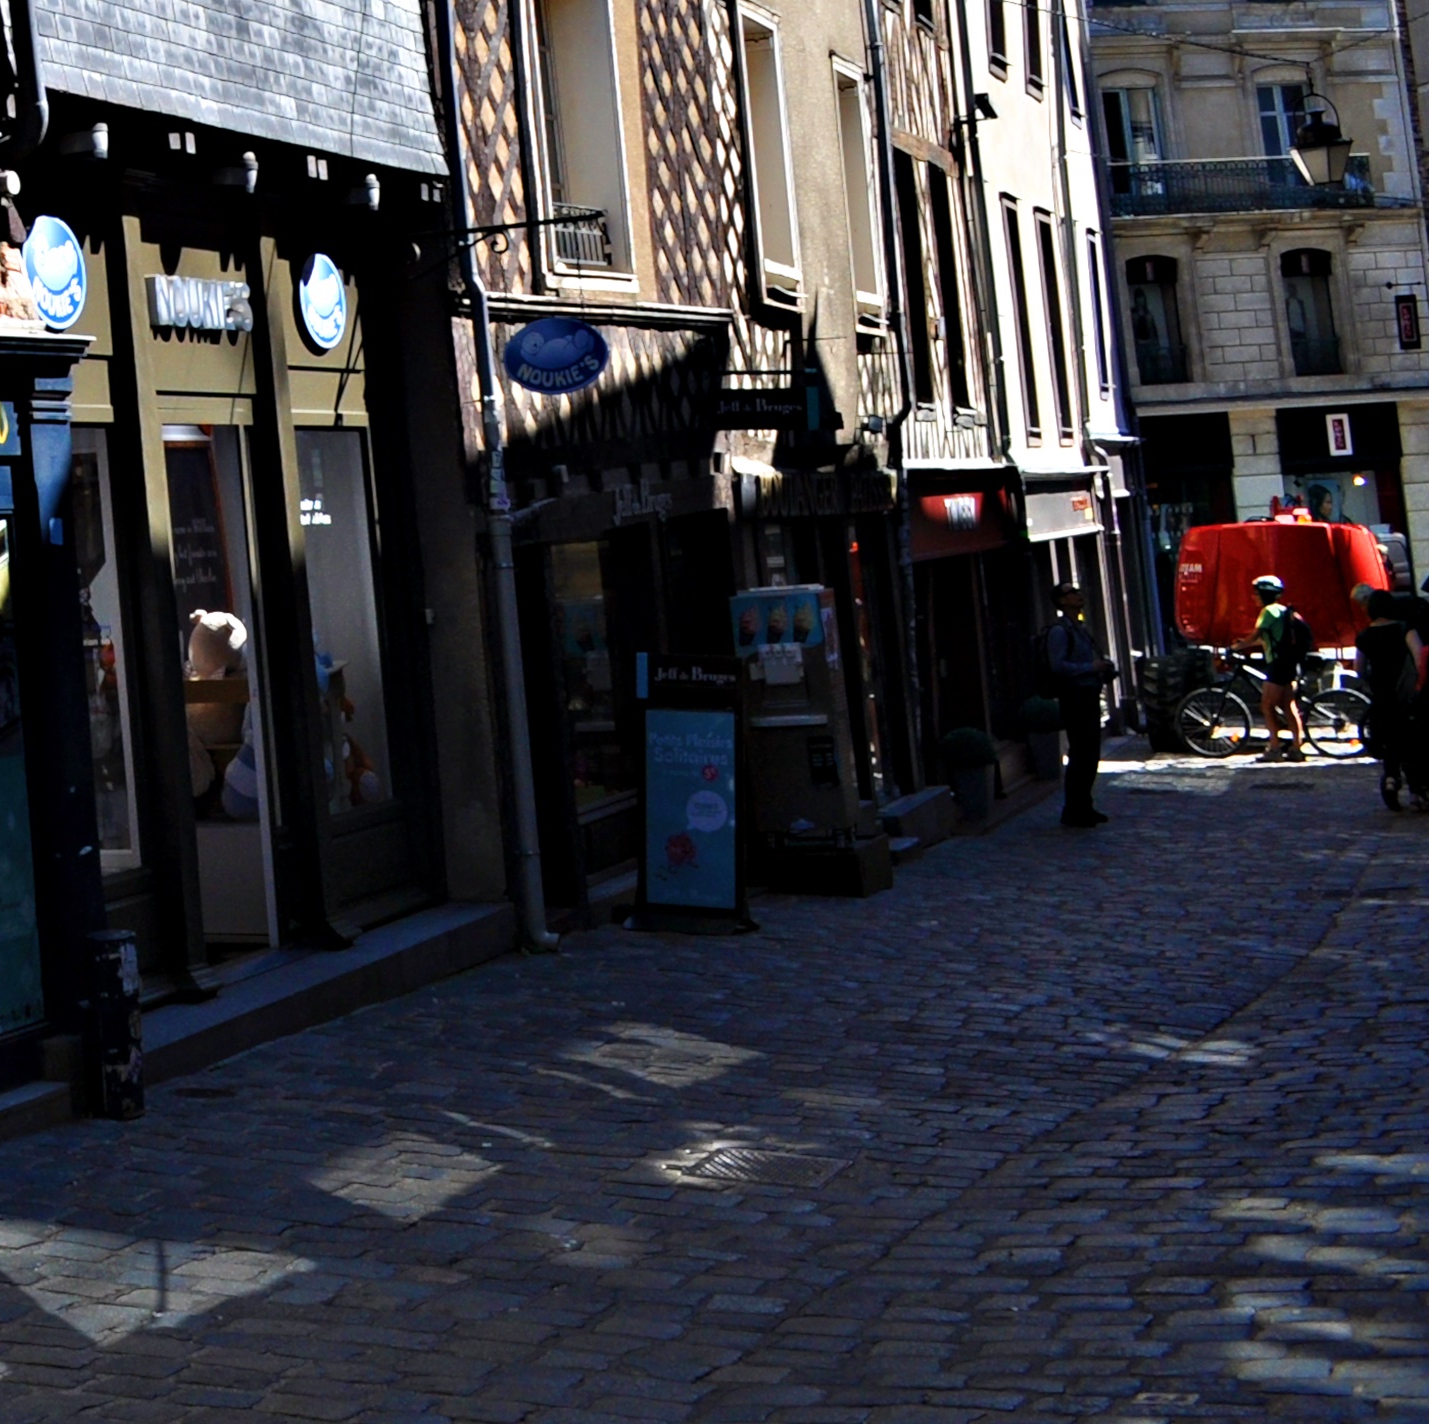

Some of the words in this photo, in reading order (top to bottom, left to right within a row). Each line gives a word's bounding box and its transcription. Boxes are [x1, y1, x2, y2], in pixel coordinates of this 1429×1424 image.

[517, 355, 600, 387] NOUKIE'S
[717, 400, 740, 414] Jeff
[756, 398, 802, 415] Bruges
[654, 667, 678, 682] Jeff
[691, 666, 737, 686] Bruges
[654, 747, 729, 766] Solitaires
